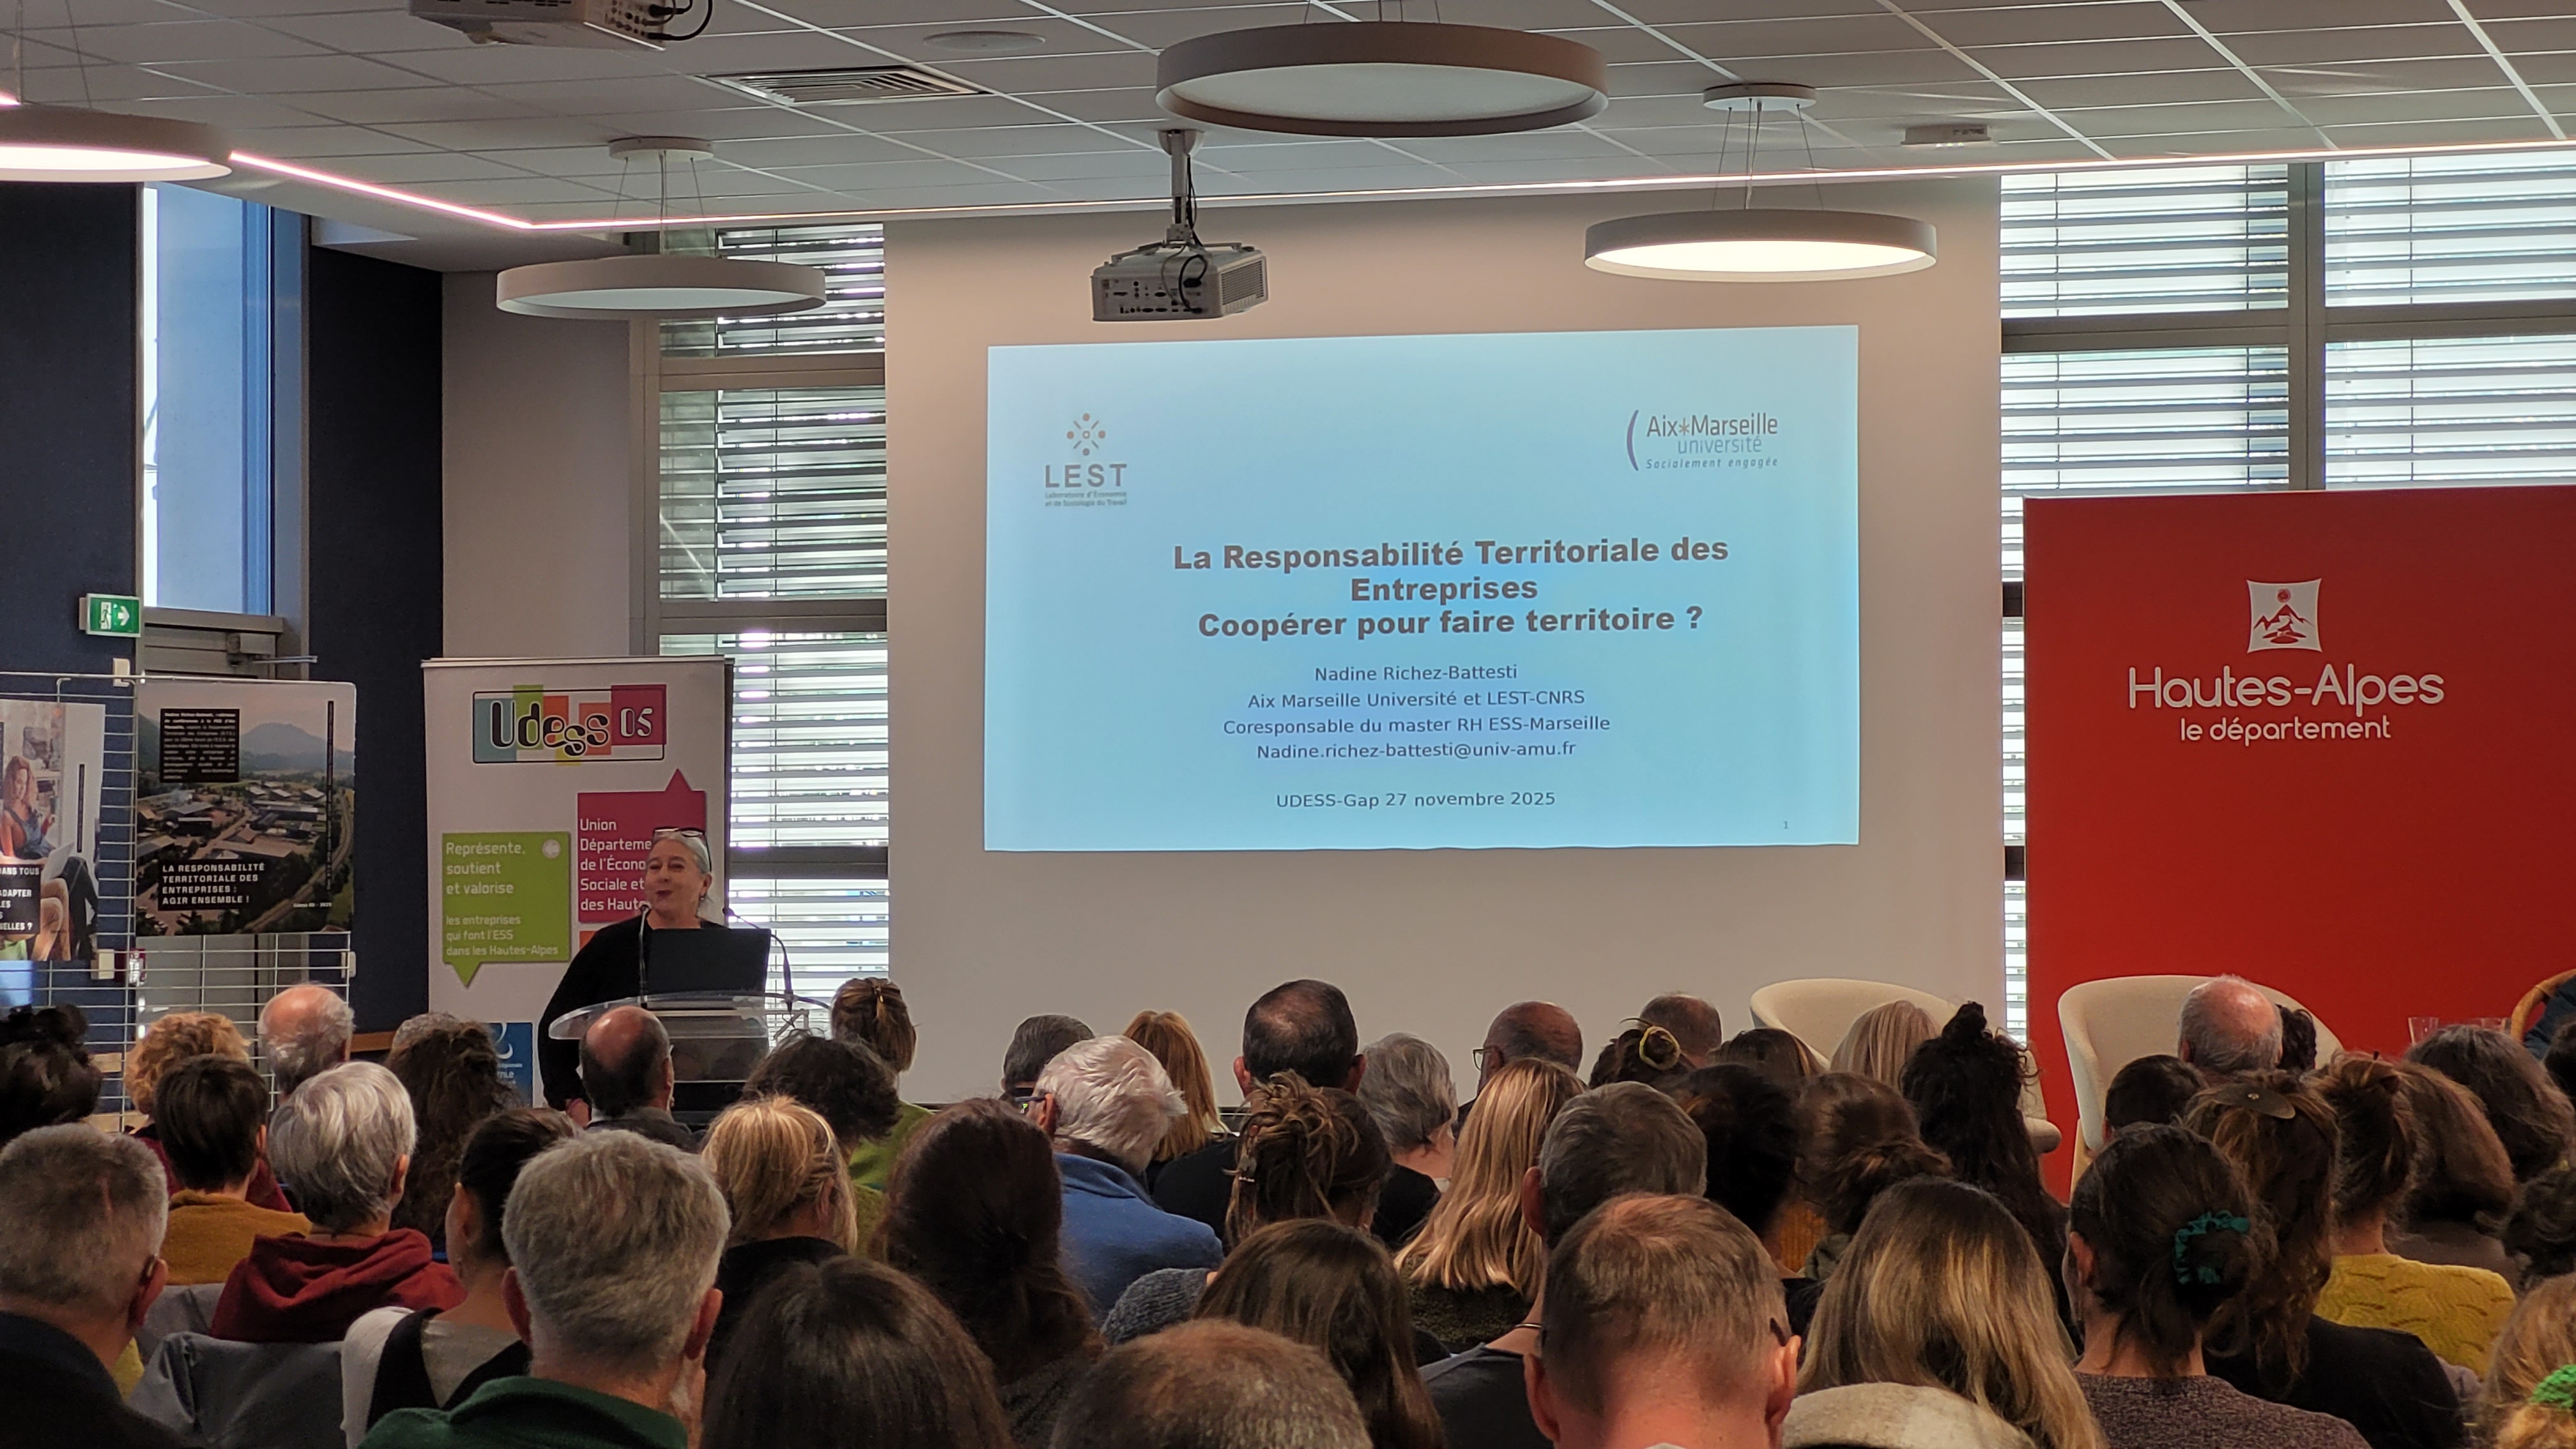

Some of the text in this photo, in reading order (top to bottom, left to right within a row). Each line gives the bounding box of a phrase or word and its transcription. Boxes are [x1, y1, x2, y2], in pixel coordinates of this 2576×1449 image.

[1678, 436, 1762, 454] université
[1646, 457, 1778, 469] Socialement engagée
[1045, 463, 1128, 488] LEST
[1174, 536, 1729, 575] La Responsabilité Territoriale des
[1351, 576, 1538, 606] Entreprises
[1199, 606, 1703, 641] Coopérer pour faire territoire ?
[1315, 664, 1517, 682] Nadine Richez-Battesti
[2129, 663, 2444, 717] Hautes-Alpes
[1248, 689, 1585, 709] Aix Marseille Université et LEST-CNRS
[620, 707, 653, 737] 05
[1223, 715, 1611, 737] Coresponsable du master RH ESS-Marseille
[2181, 714, 2391, 747] le département
[1257, 740, 1577, 761] Nadine.richez-battesti@univ-amu.fr
[1276, 791, 1555, 811] UDESS-Gap 27 novembre 2025
[579, 818, 617, 831] Union
[1782, 821, 1790, 829] 1
[580, 838, 652, 854] Départeme
[162, 862, 265, 873] LA RESPONSABILITÉ
[447, 862, 501, 875] soutient
[580, 855, 646, 871] de l'Écono
[0, 867, 17, 875] ANS
[162, 875, 236, 884] TERRITORIALE
[580, 878, 645, 891] Sociale et
[162, 885, 231, 894] ENTREPRISES
[447, 882, 514, 894] et valorise
[162, 896, 188, 905] AGIR
[192, 896, 243, 904] ENSEMBLE
[580, 898, 604, 911] des
[447, 915, 521, 926] les entreprises
[447, 932, 461, 942] qui
[463, 930, 485, 940] font
[447, 945, 558, 957] dans les Hautes-Alpes
